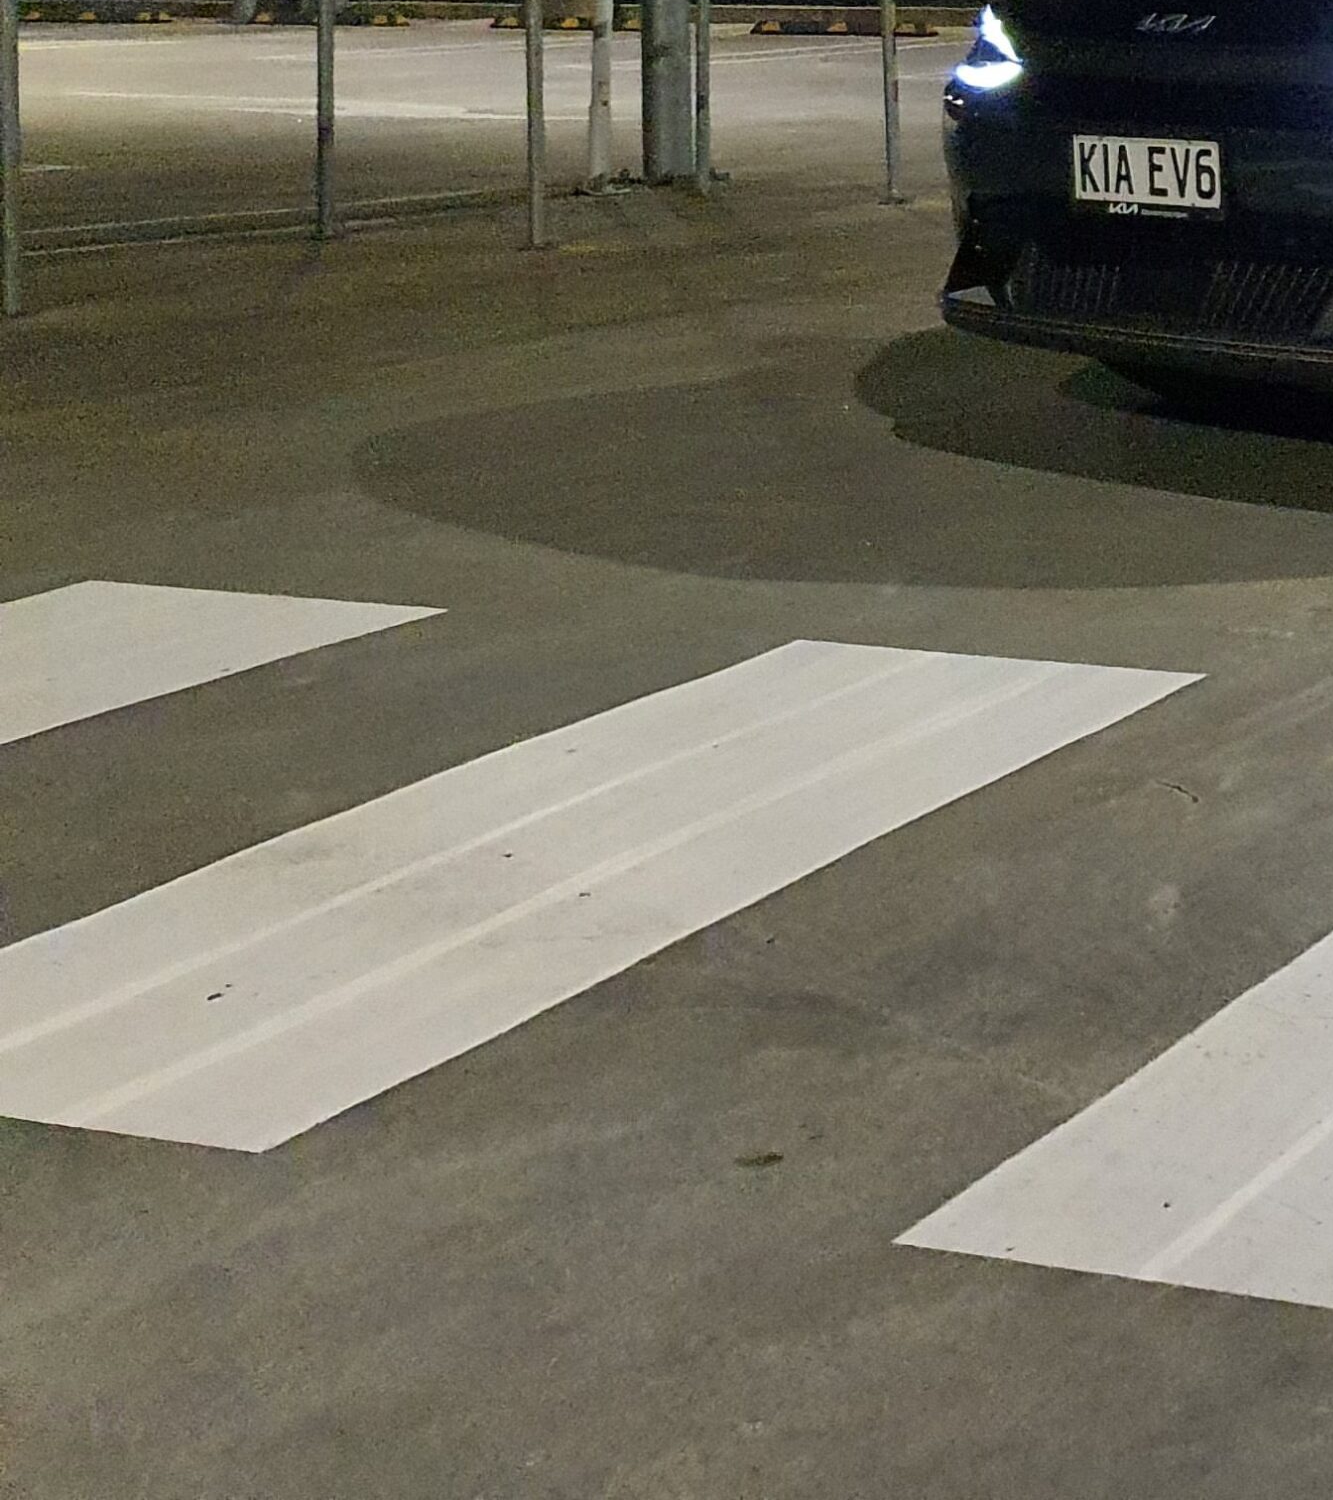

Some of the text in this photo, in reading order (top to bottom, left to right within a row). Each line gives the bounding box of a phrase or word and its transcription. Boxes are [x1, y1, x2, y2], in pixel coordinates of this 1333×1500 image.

[1078, 142, 1216, 199] KIA EV6
[1108, 202, 1139, 215] KIA
